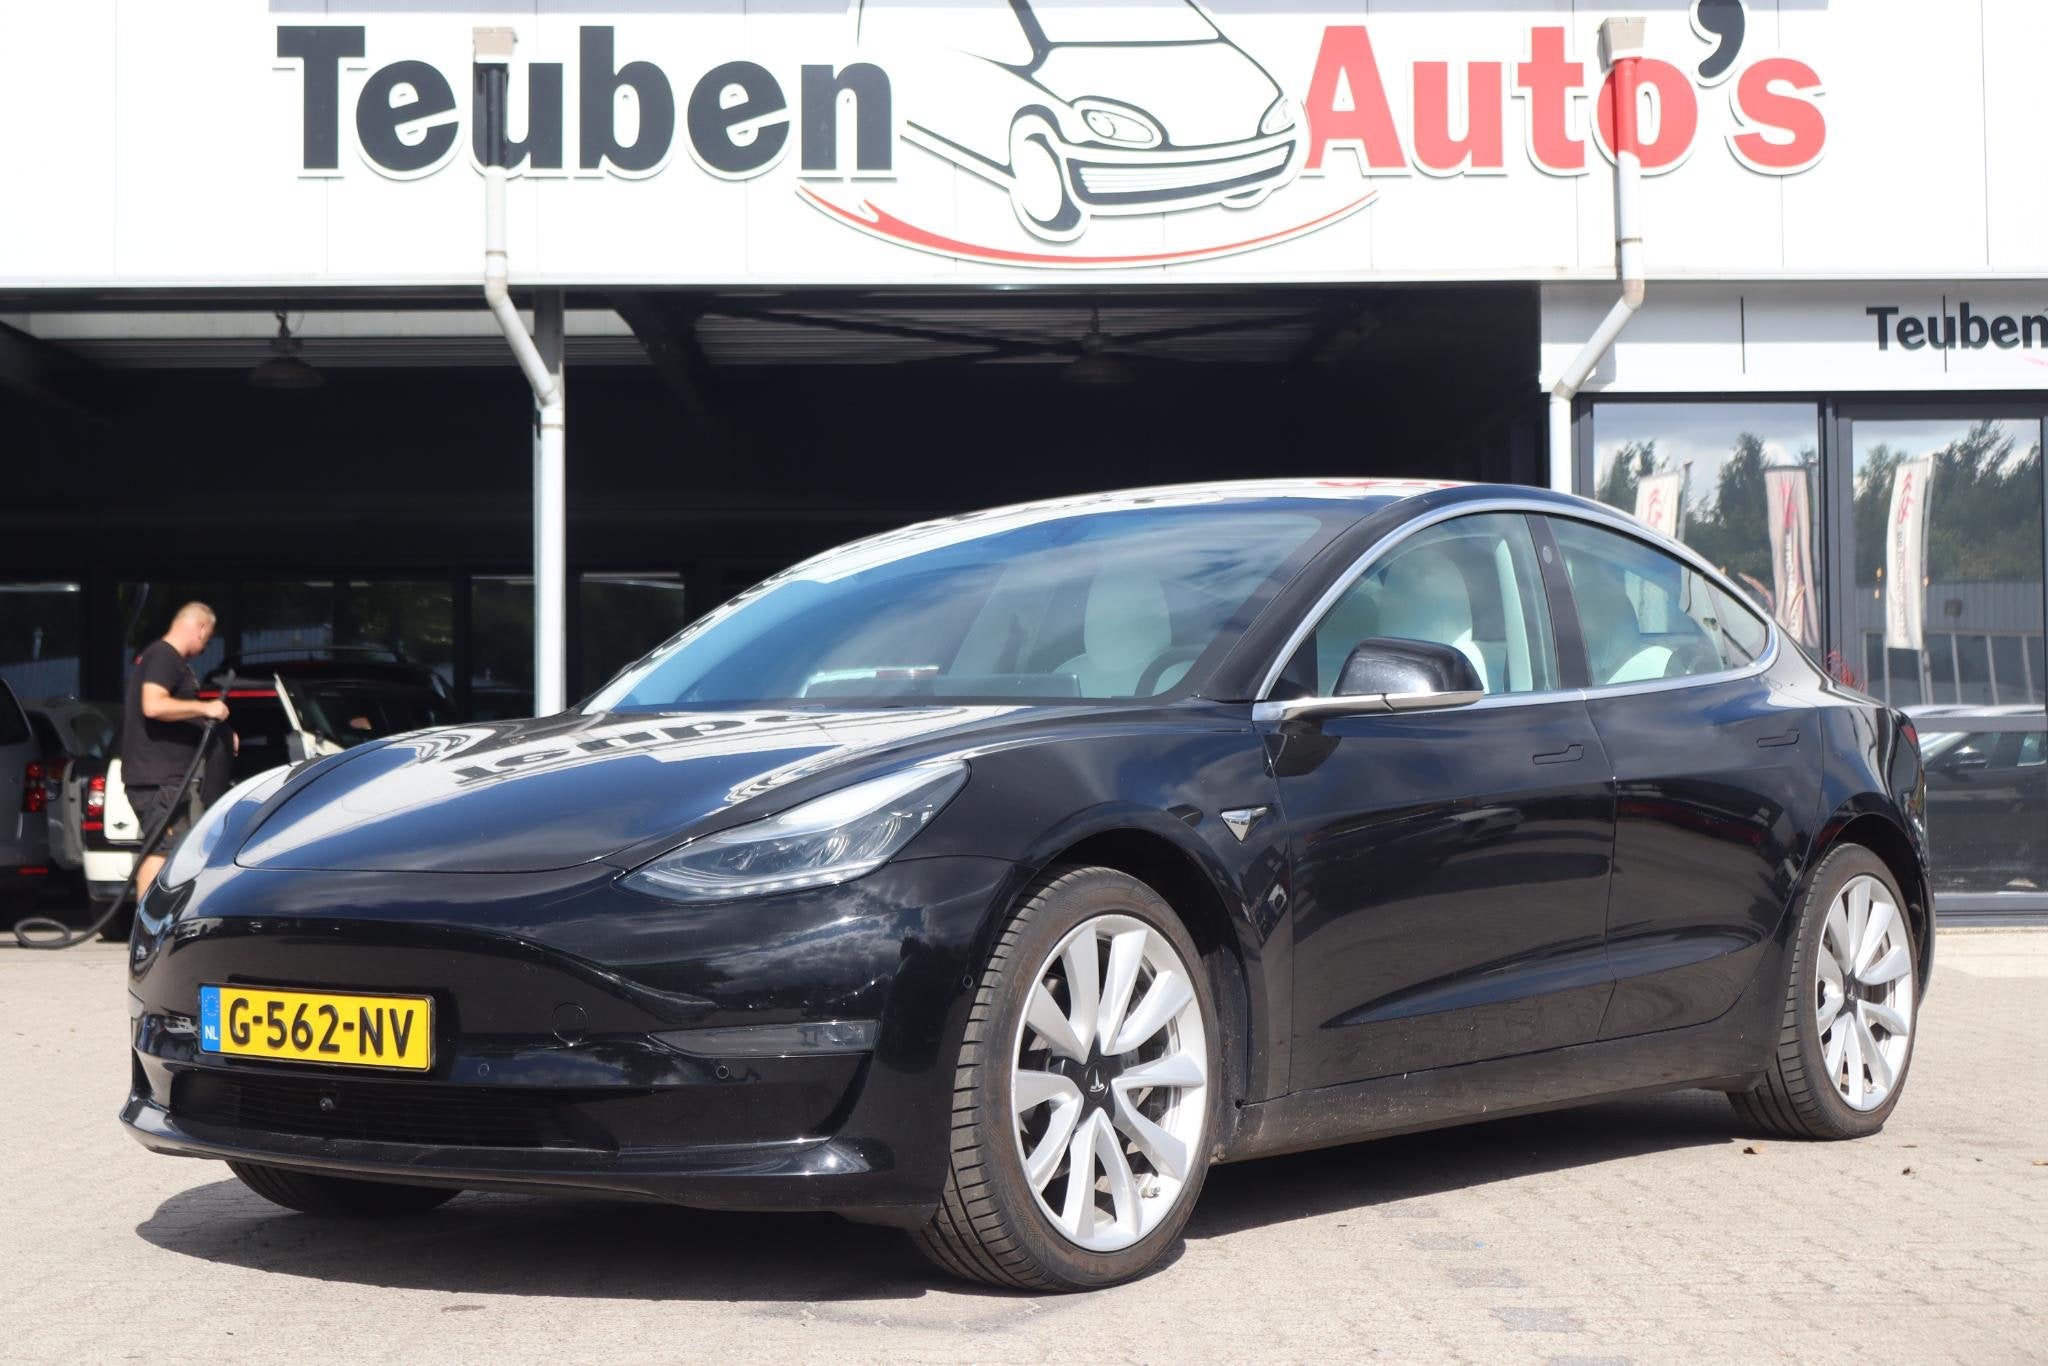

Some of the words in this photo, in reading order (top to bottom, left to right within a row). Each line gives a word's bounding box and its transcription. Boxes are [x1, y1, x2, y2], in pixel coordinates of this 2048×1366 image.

[275, 25, 893, 173] Teuben
[1304, 0, 1827, 169] Auto's
[1866, 302, 2048, 350] Teuben
[204, 1025, 219, 1041] NL
[229, 998, 415, 1058] G-562-NV
